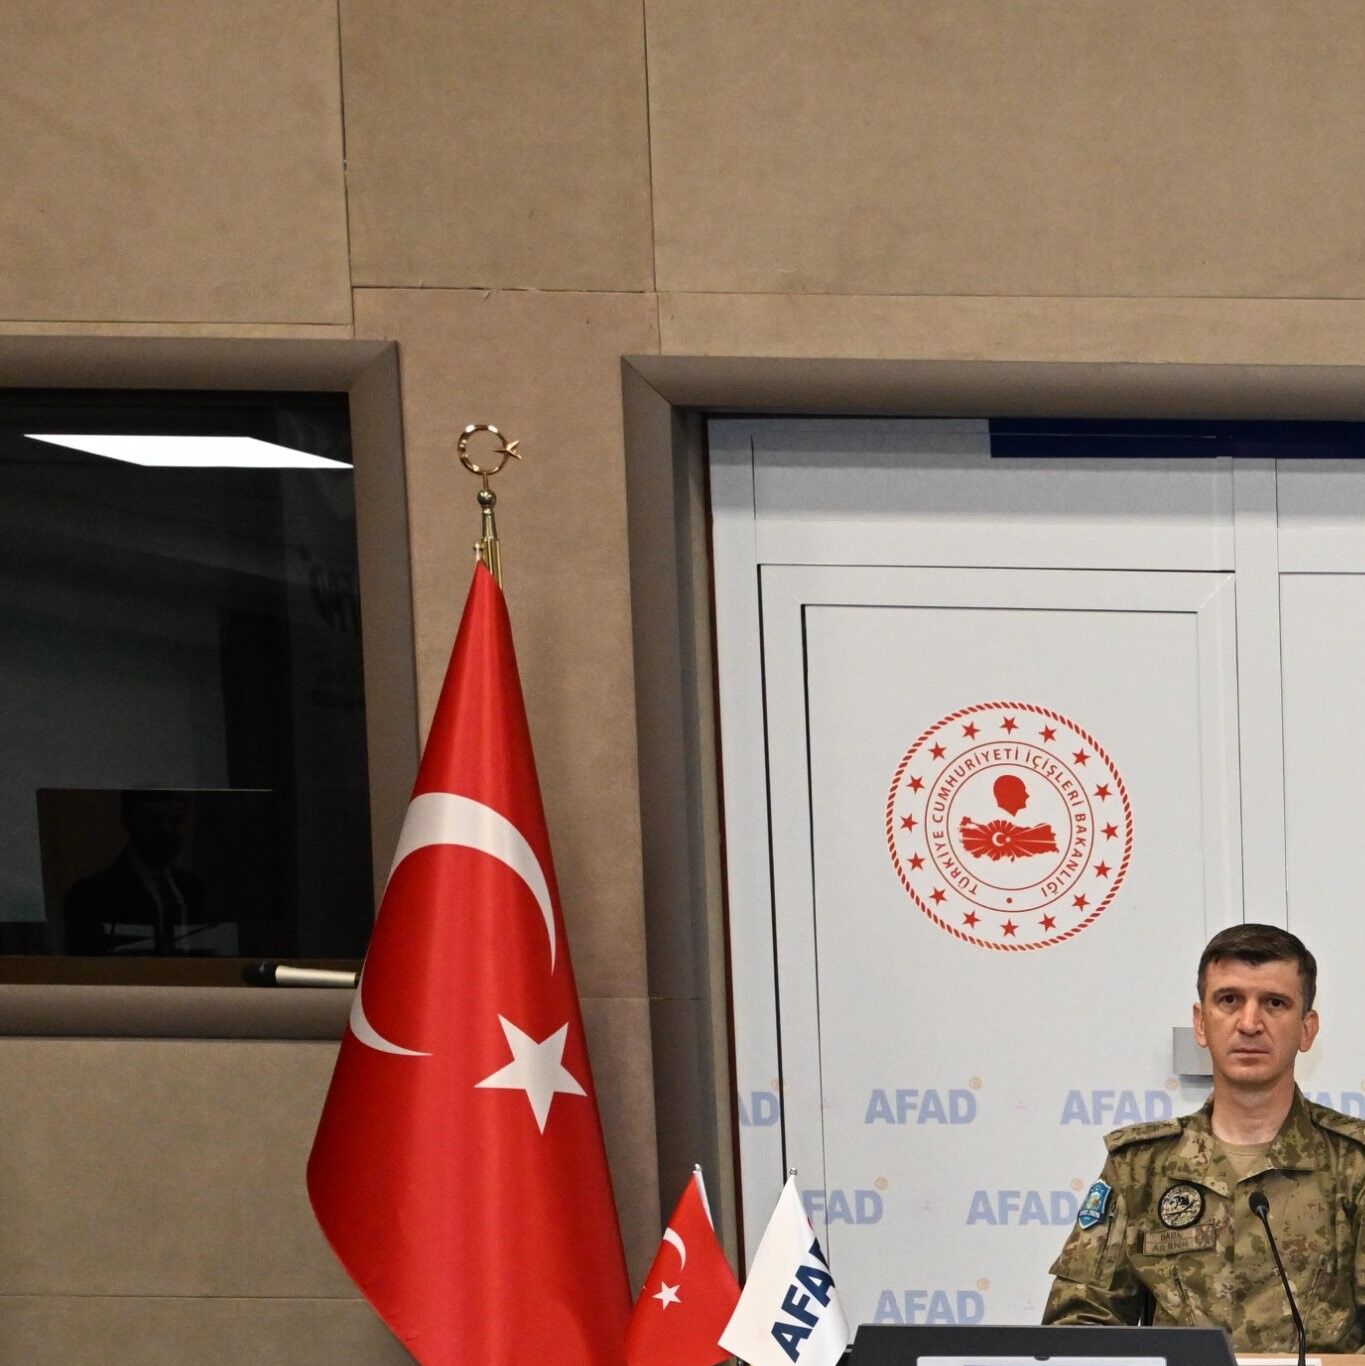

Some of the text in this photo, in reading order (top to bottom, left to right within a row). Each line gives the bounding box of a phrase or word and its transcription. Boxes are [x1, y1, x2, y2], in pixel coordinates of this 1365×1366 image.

[932, 746, 1088, 898] TÜRKİYE CUMHURİYETİ İÇİŞLERİ BAKANLIĞI
[864, 1089, 977, 1125] AFAD
[1060, 1090, 1173, 1125] AFAD
[801, 1190, 883, 1225] FAD
[966, 1190, 1078, 1225] AFAD
[873, 1290, 985, 1325] AFAD
